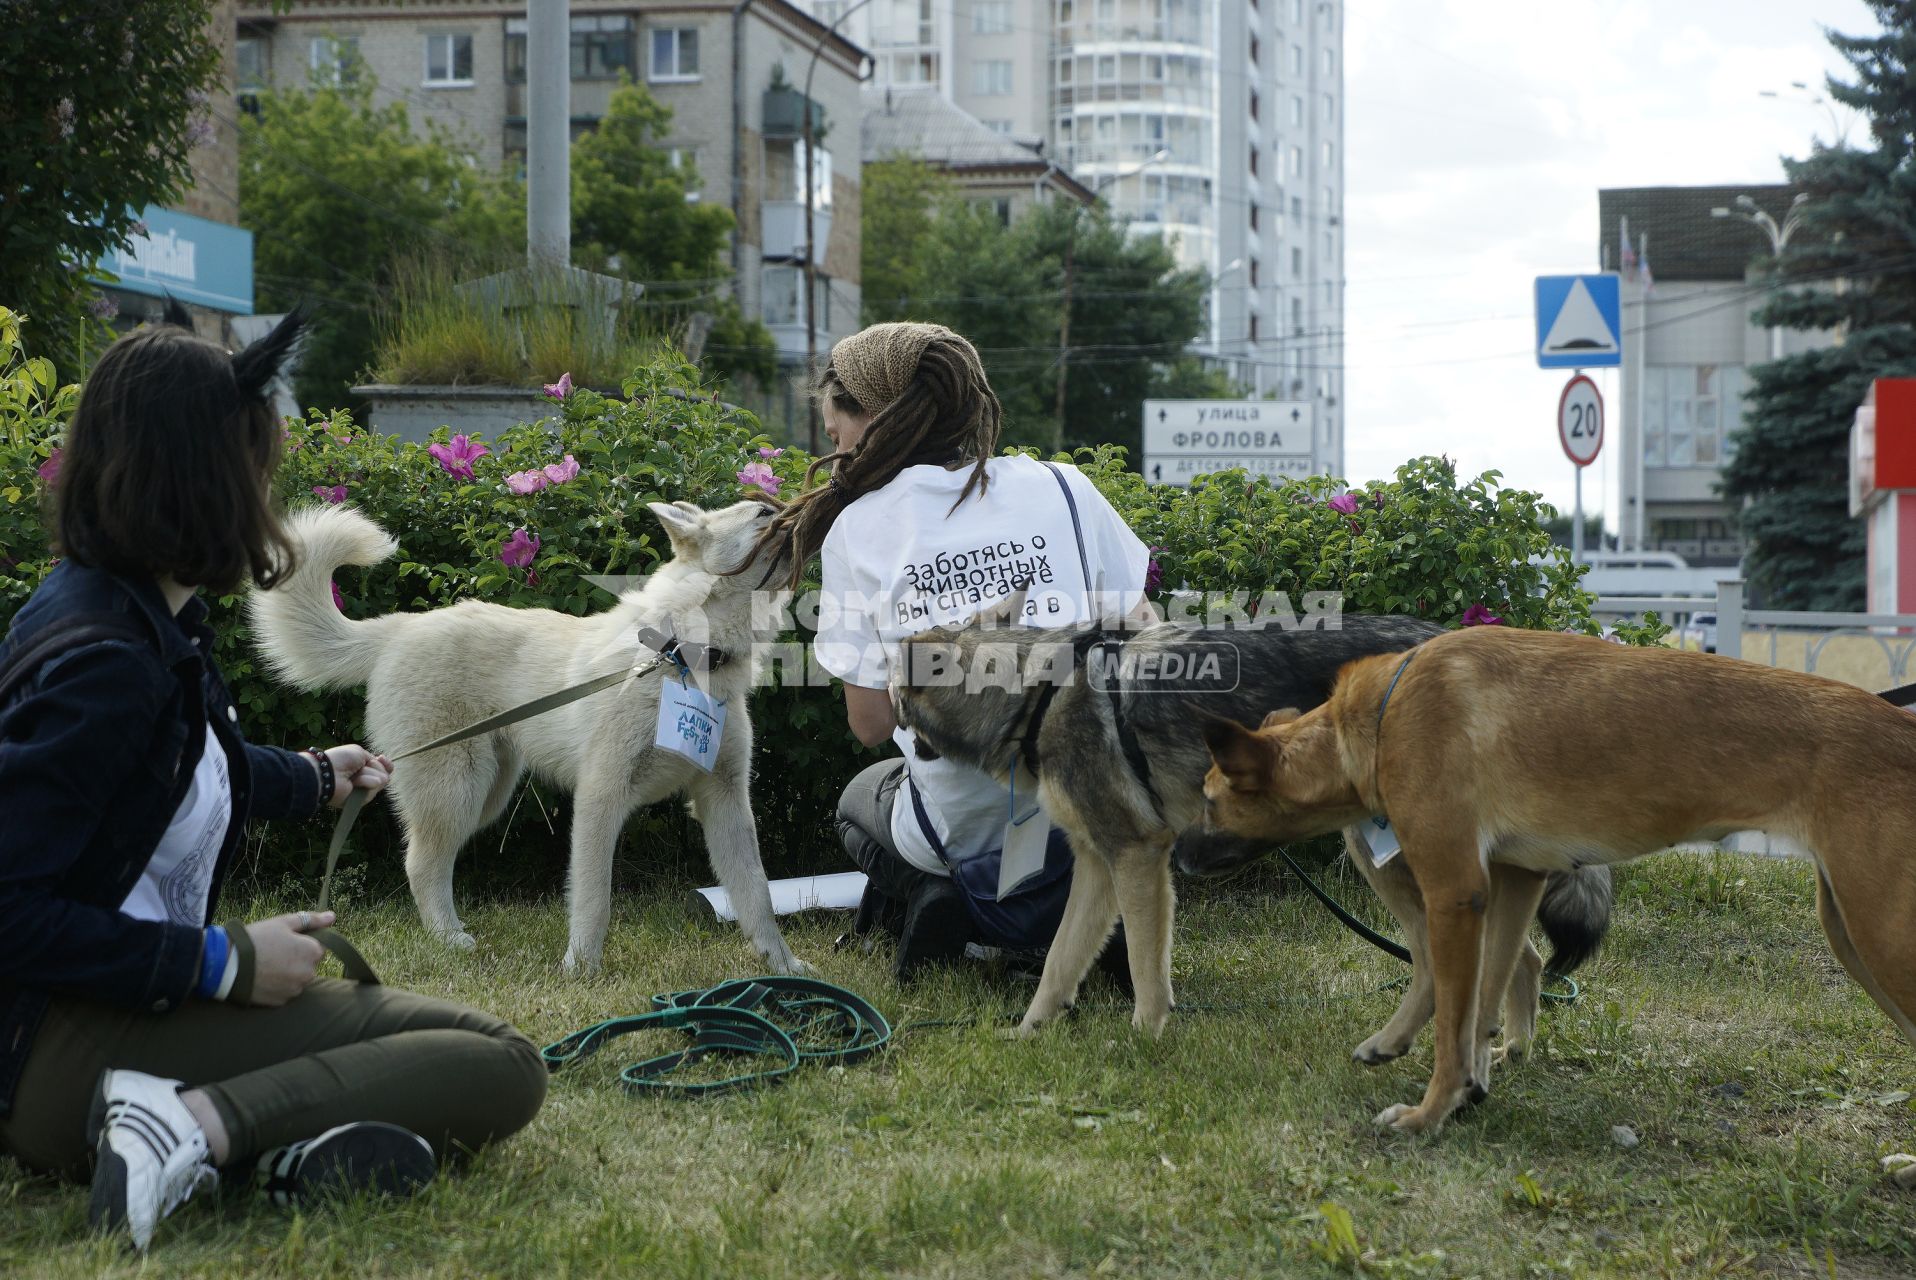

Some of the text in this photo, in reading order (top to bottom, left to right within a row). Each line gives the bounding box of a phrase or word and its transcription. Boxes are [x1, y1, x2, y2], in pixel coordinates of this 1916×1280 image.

[1197, 406, 1259, 423] улица
[1571, 403, 1597, 438] 20
[1172, 431, 1283, 448] ФРОЛОВА
[903, 535, 1047, 585] Заботясь о
[914, 554, 1051, 599] животных
[896, 599, 930, 625] Вы
[936, 567, 1054, 611] спасаете
[678, 710, 713, 736] ЛАПКИ
